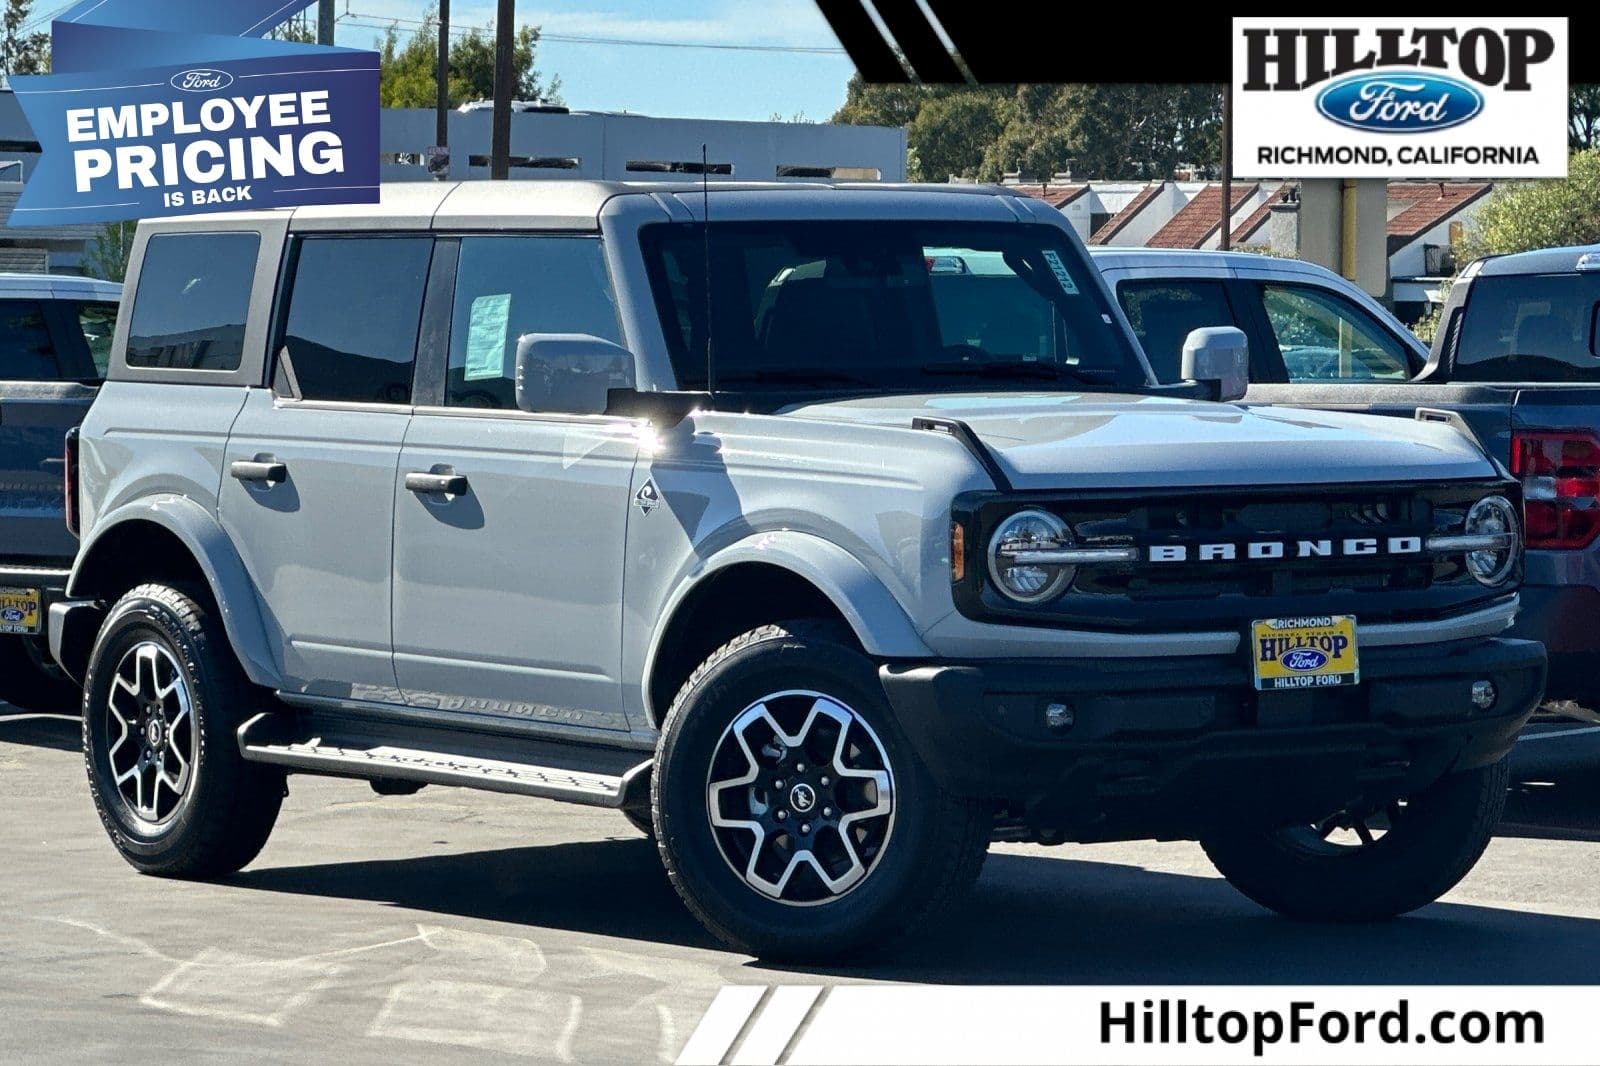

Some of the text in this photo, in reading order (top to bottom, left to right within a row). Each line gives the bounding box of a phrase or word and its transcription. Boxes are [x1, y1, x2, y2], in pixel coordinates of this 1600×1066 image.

[1149, 536, 1421, 562] BRONCO
[1278, 617, 1331, 629] RICHMOND
[1260, 635, 1348, 662] HILLTOP
[1289, 652, 1319, 668] Ford
[1274, 676, 1314, 688] HILLTOP
